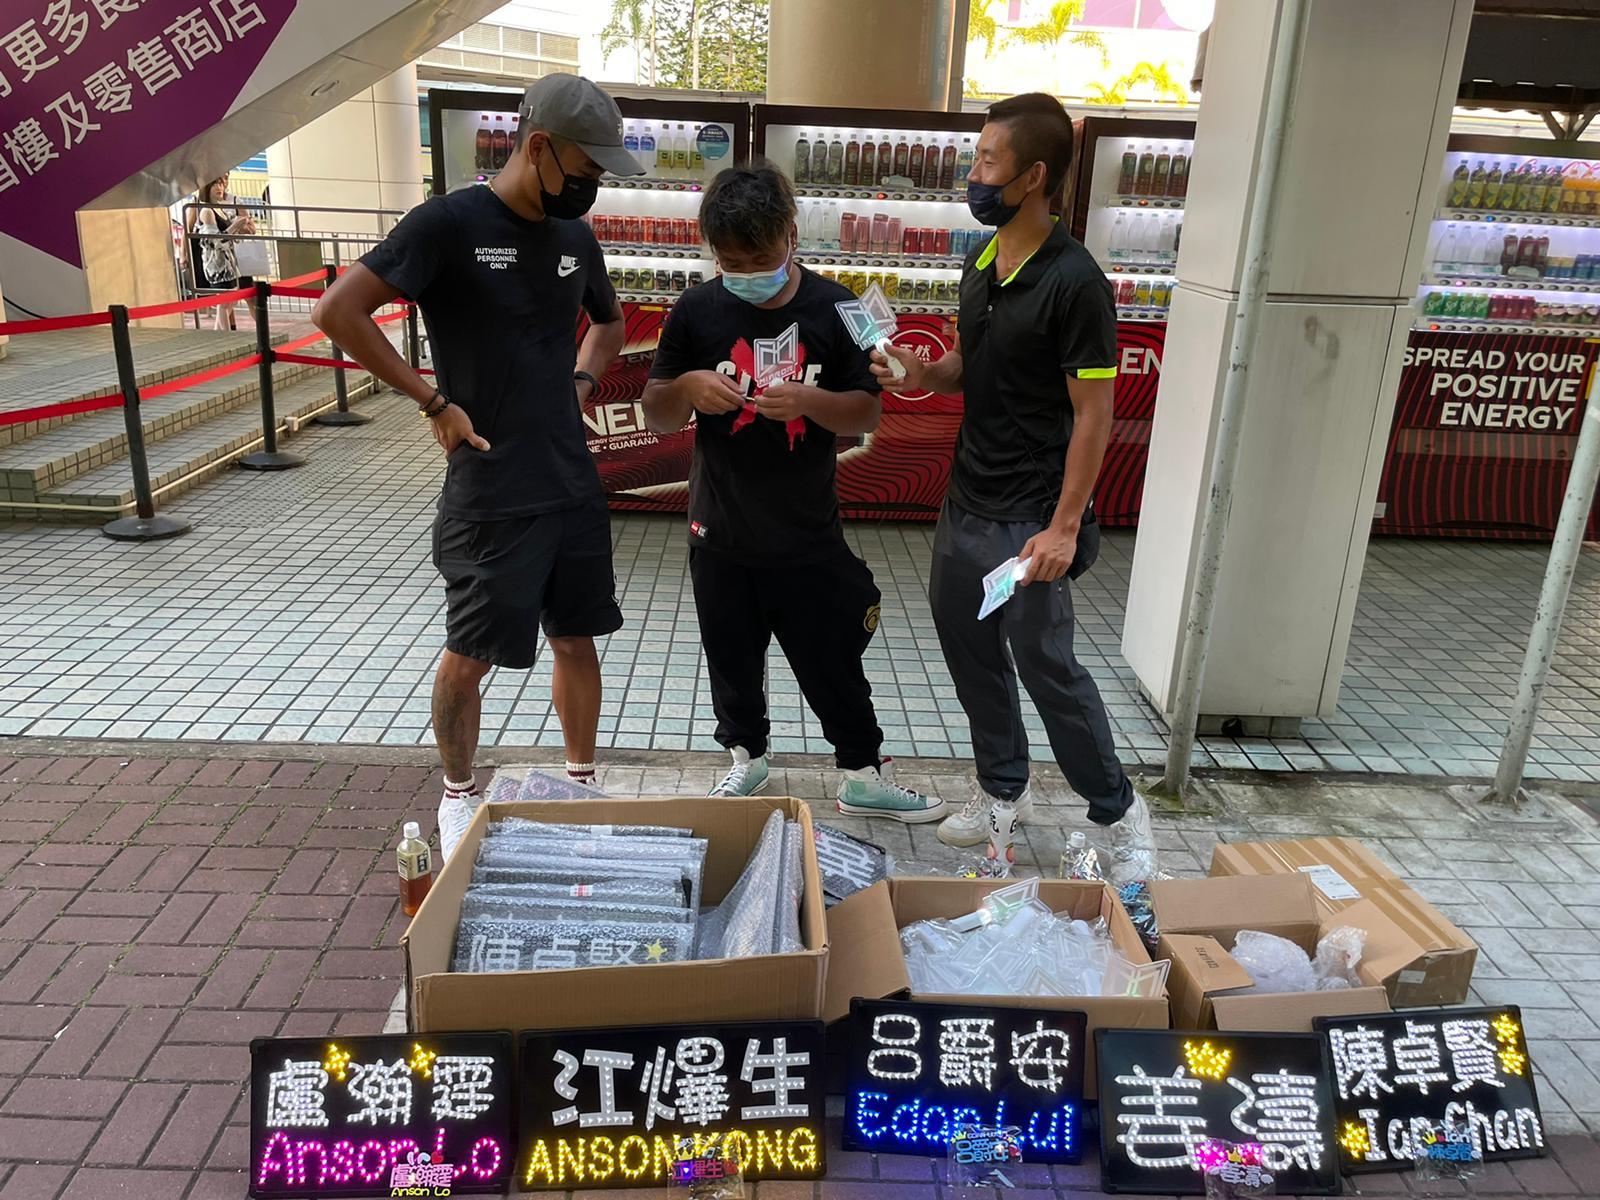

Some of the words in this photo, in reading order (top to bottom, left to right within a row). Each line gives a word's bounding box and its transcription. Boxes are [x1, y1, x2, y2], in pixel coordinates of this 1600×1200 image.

[474, 247, 518, 256] AUTHORIZED
[476, 255, 518, 263] PERSONNEL
[489, 262, 508, 270] ONLY
[560, 254, 578, 269] NIKE
[1402, 346, 1505, 370] SPREAD
[1513, 351, 1586, 374] YOUR
[1429, 372, 1581, 403] POSITIVE
[1439, 401, 1575, 431] ENERGY
[608, 436, 660, 452] GUARANA
[1329, 1019, 1506, 1100] 陳卓賢
[525, 1134, 682, 1184] ANSON
[390, 1187, 430, 1198] Anson
[434, 1186, 451, 1197] Lo
